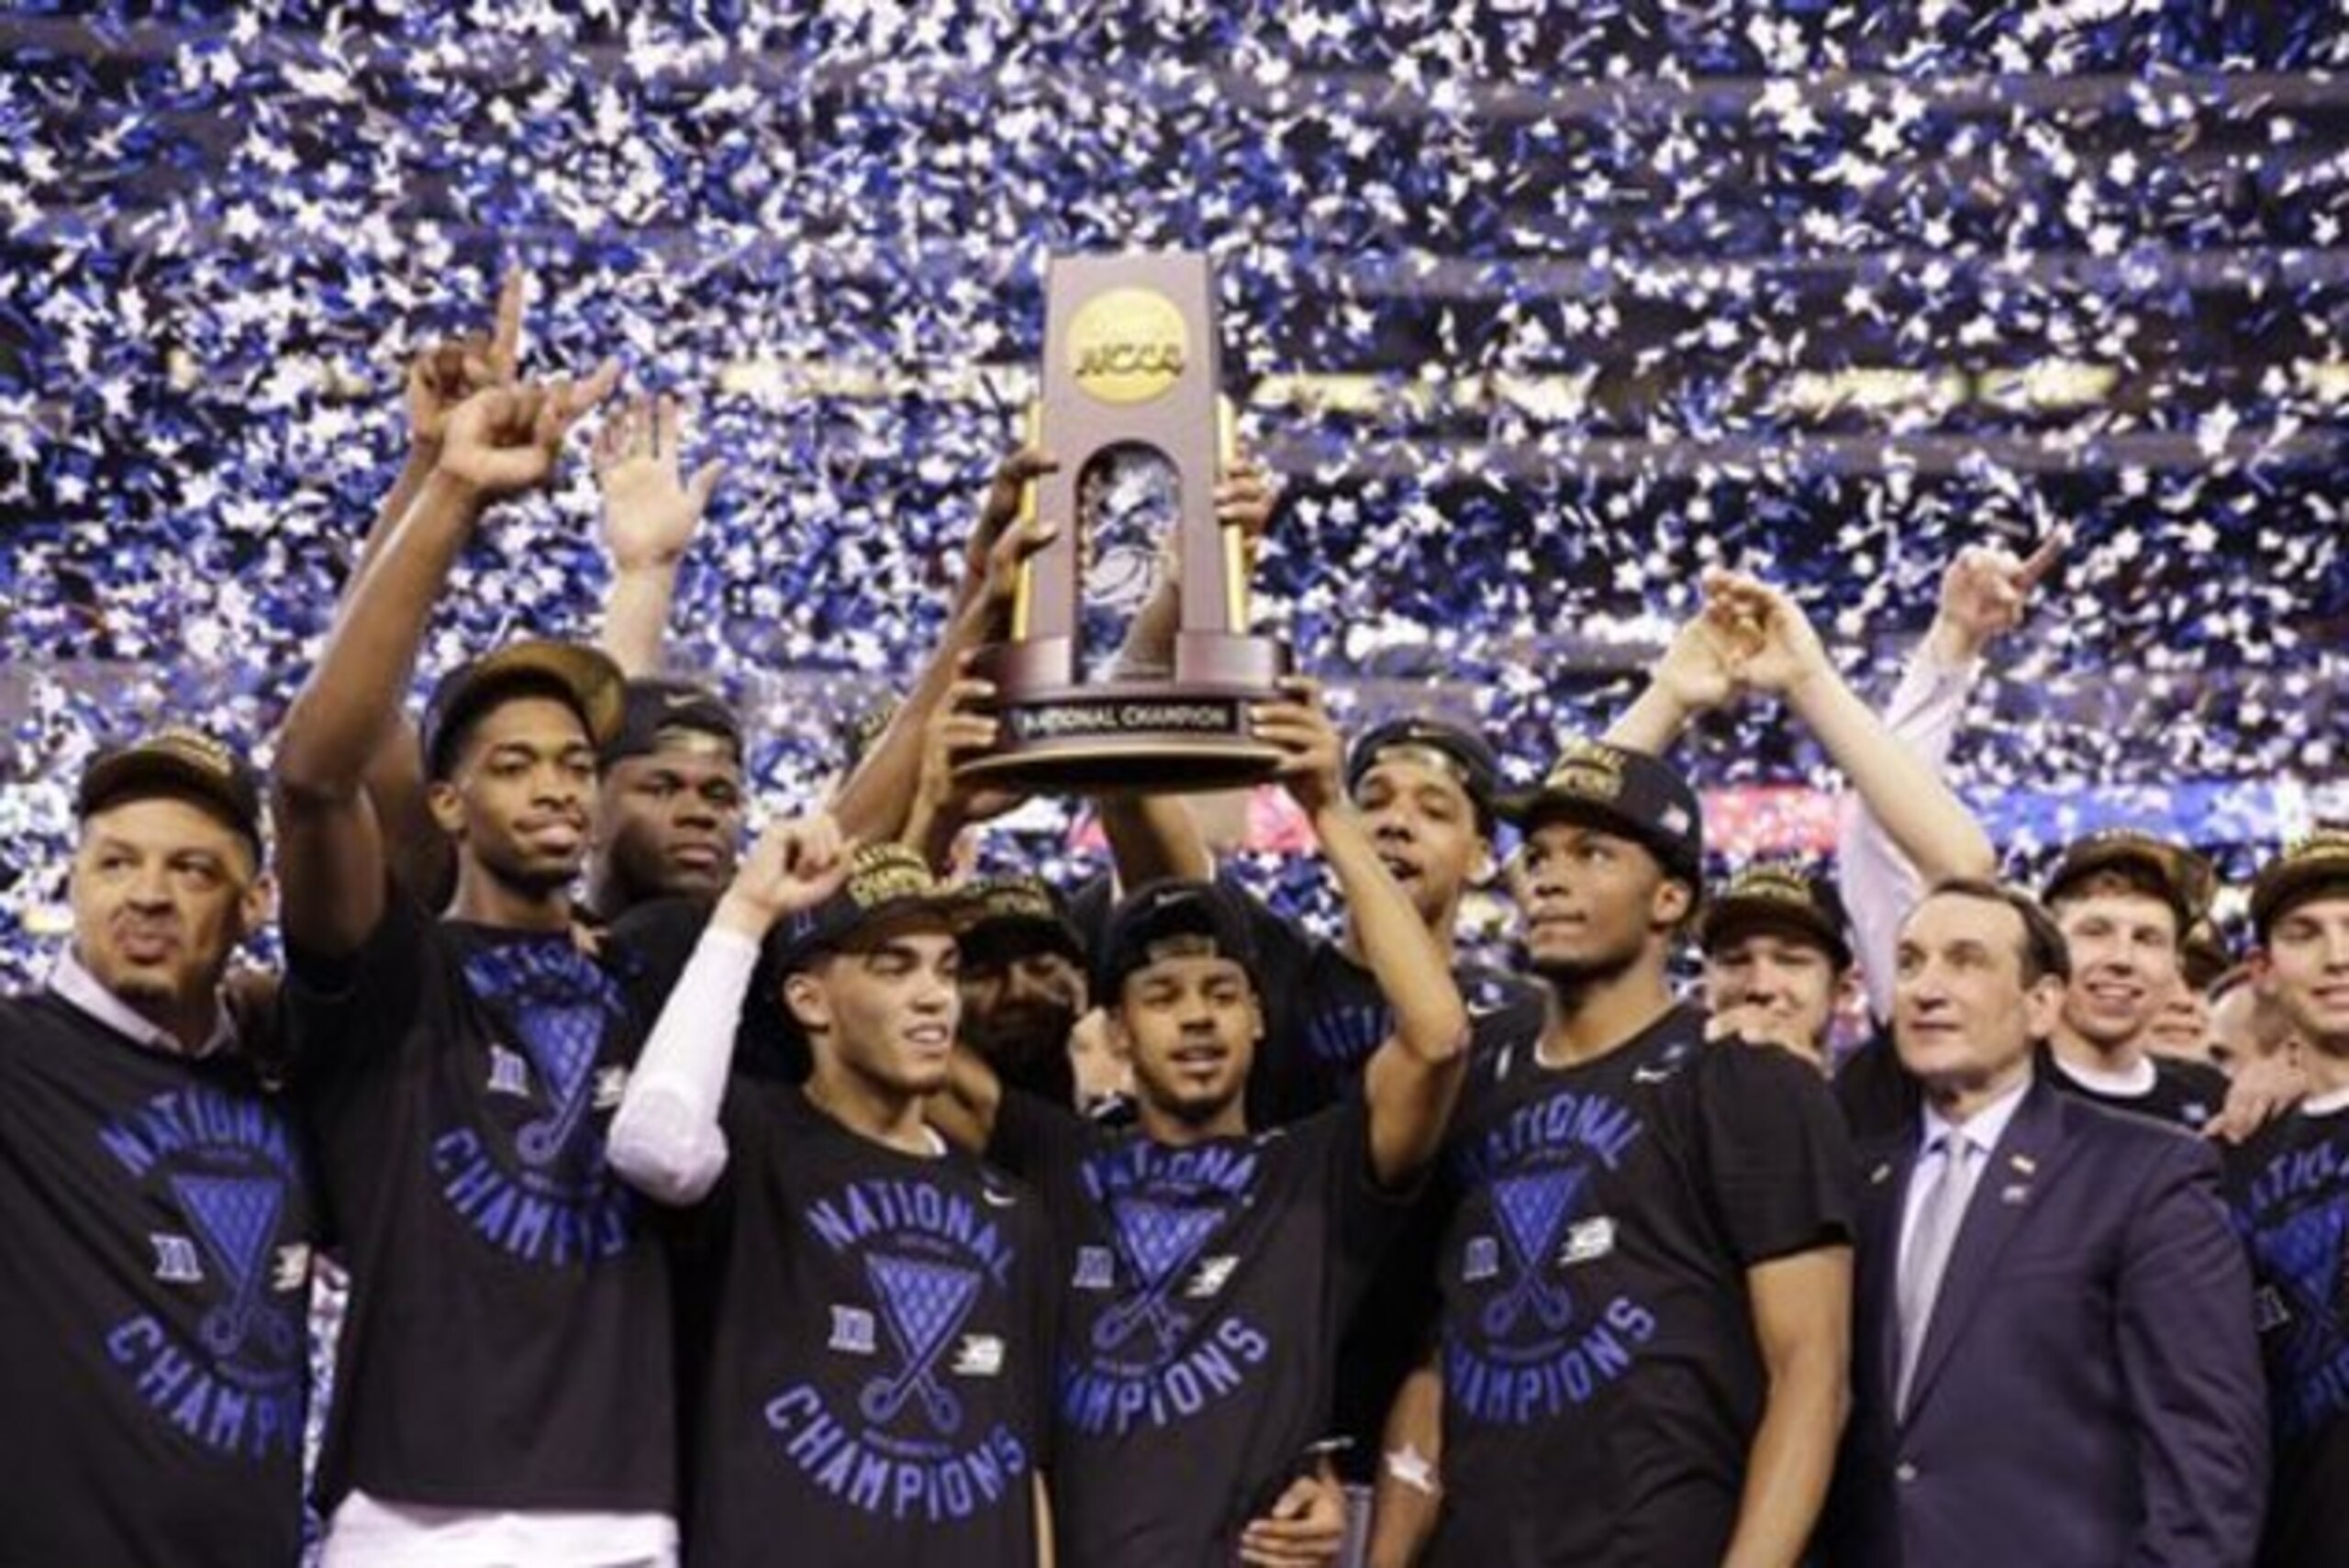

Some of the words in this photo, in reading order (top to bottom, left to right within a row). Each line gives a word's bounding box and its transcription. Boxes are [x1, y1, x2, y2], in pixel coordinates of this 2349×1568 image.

[99, 1086, 297, 1178] NATIONA
[806, 1180, 1014, 1288] NATIONAL
[764, 1384, 1026, 1521] CHAMPIONS
